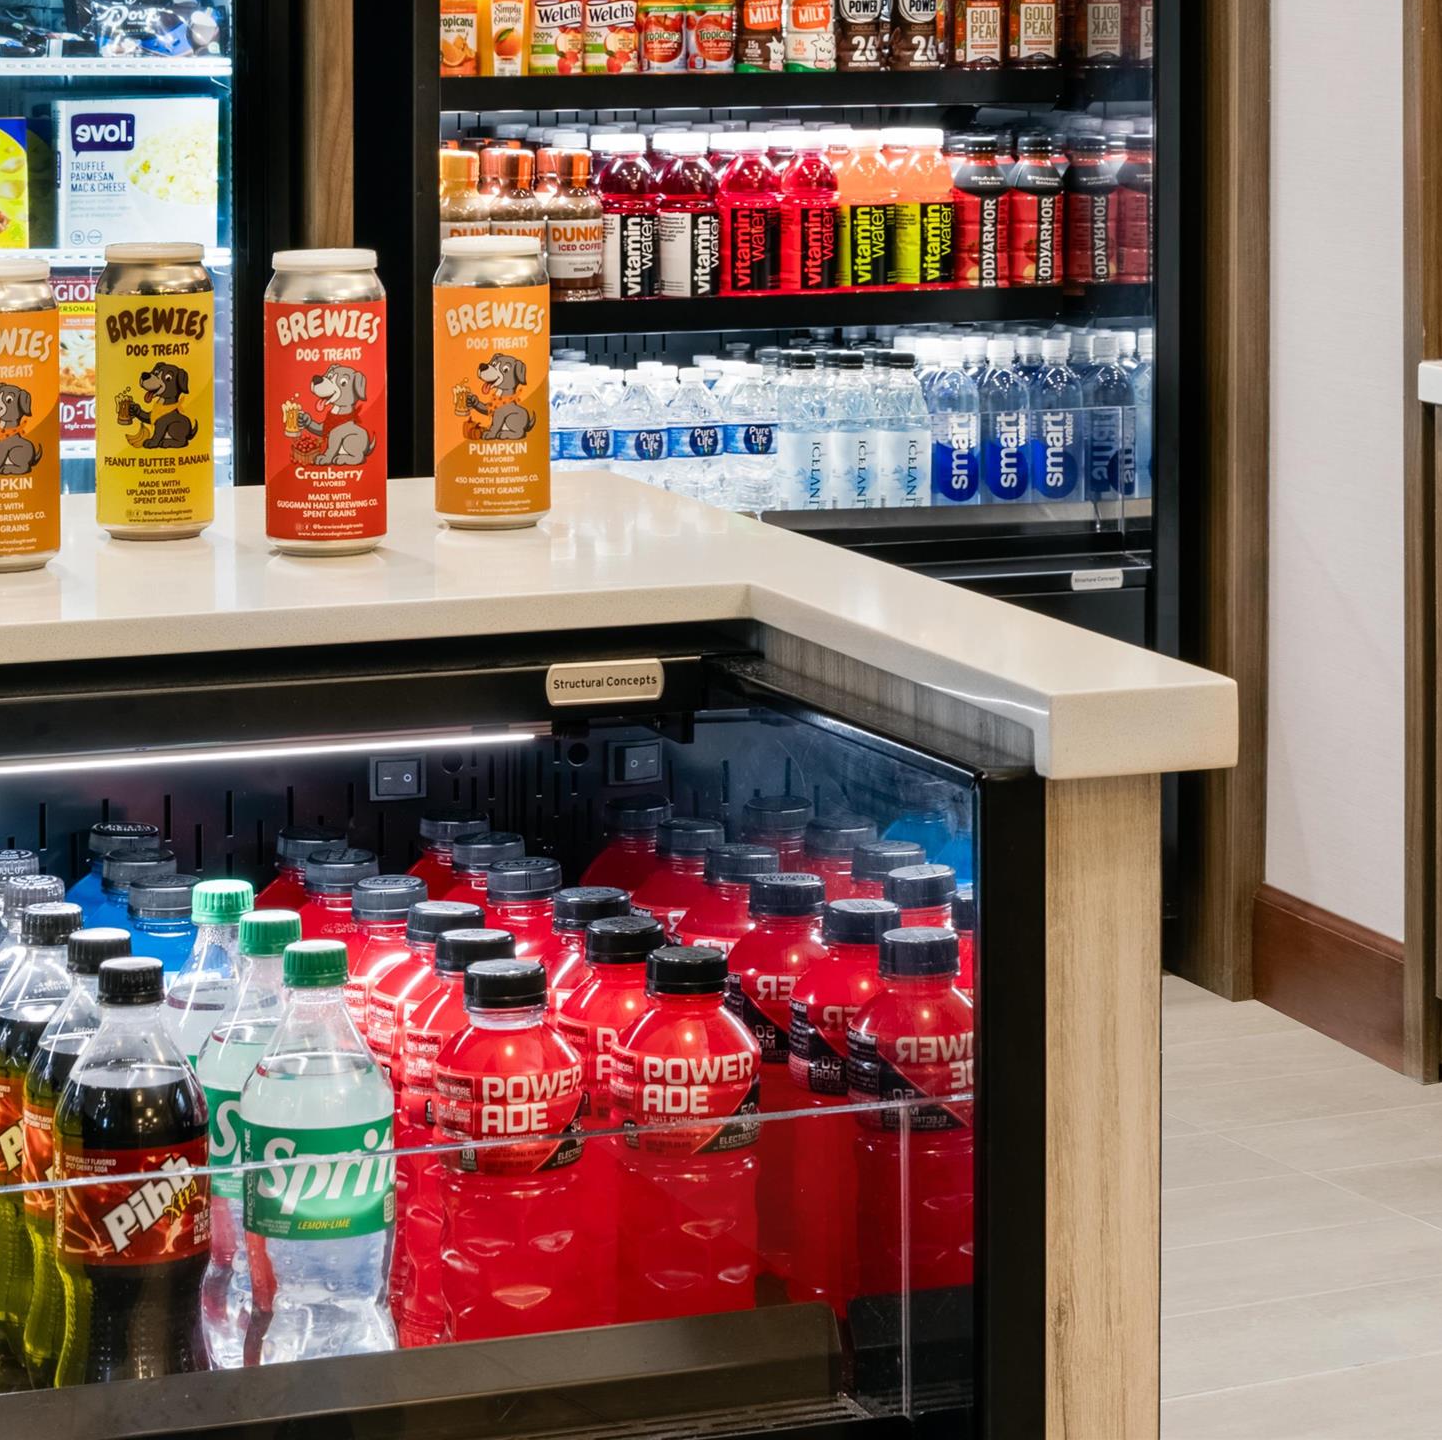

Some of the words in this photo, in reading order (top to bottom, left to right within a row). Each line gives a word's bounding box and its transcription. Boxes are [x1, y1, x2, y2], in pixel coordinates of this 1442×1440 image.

[589, 0, 635, 24] Welch's
[849, 0, 878, 13] POWER
[1020, 7, 1053, 21] GOLD
[748, 7, 779, 25] MILK
[971, 10, 998, 25] GOLD
[971, 24, 998, 39] PEAK
[1022, 20, 1053, 35] PEAK
[852, 36, 877, 60] 26
[75, 120, 133, 143] evol.
[71, 162, 105, 171] TRUFFLE
[71, 172, 114, 181] PARMESAN
[71, 183, 88, 192] MAC
[97, 182, 126, 192] CHEESE
[982, 198, 997, 288] BODYARMOR
[626, 216, 641, 297] vitamin
[105, 306, 208, 344] BREWIES
[445, 301, 544, 337] BREWIES
[276, 308, 381, 346] BREWIES
[126, 344, 149, 357] DOG
[151, 343, 189, 356] TREATS
[694, 428, 715, 438] Pure
[469, 442, 527, 455] PUMPKIN
[951, 413, 968, 489] smart
[104, 456, 136, 467] PEANUT
[138, 456, 175, 467] BUTTER
[177, 454, 210, 465] BANANA
[295, 467, 363, 482] Cranberry
[126, 488, 155, 496] UPLAND
[157, 487, 190, 495] BREWING
[313, 501, 334, 509] HAUS
[336, 500, 368, 509] BREWING
[0, 523, 30, 532] GRAINS
[553, 678, 604, 690] Structural
[606, 675, 657, 687] Concepts
[642, 1084, 709, 1115] ADE
[482, 1103, 548, 1133] ADE
[101, 1155, 196, 1254] Pibb
[298, 1218, 351, 1230] LEMON-LIME
